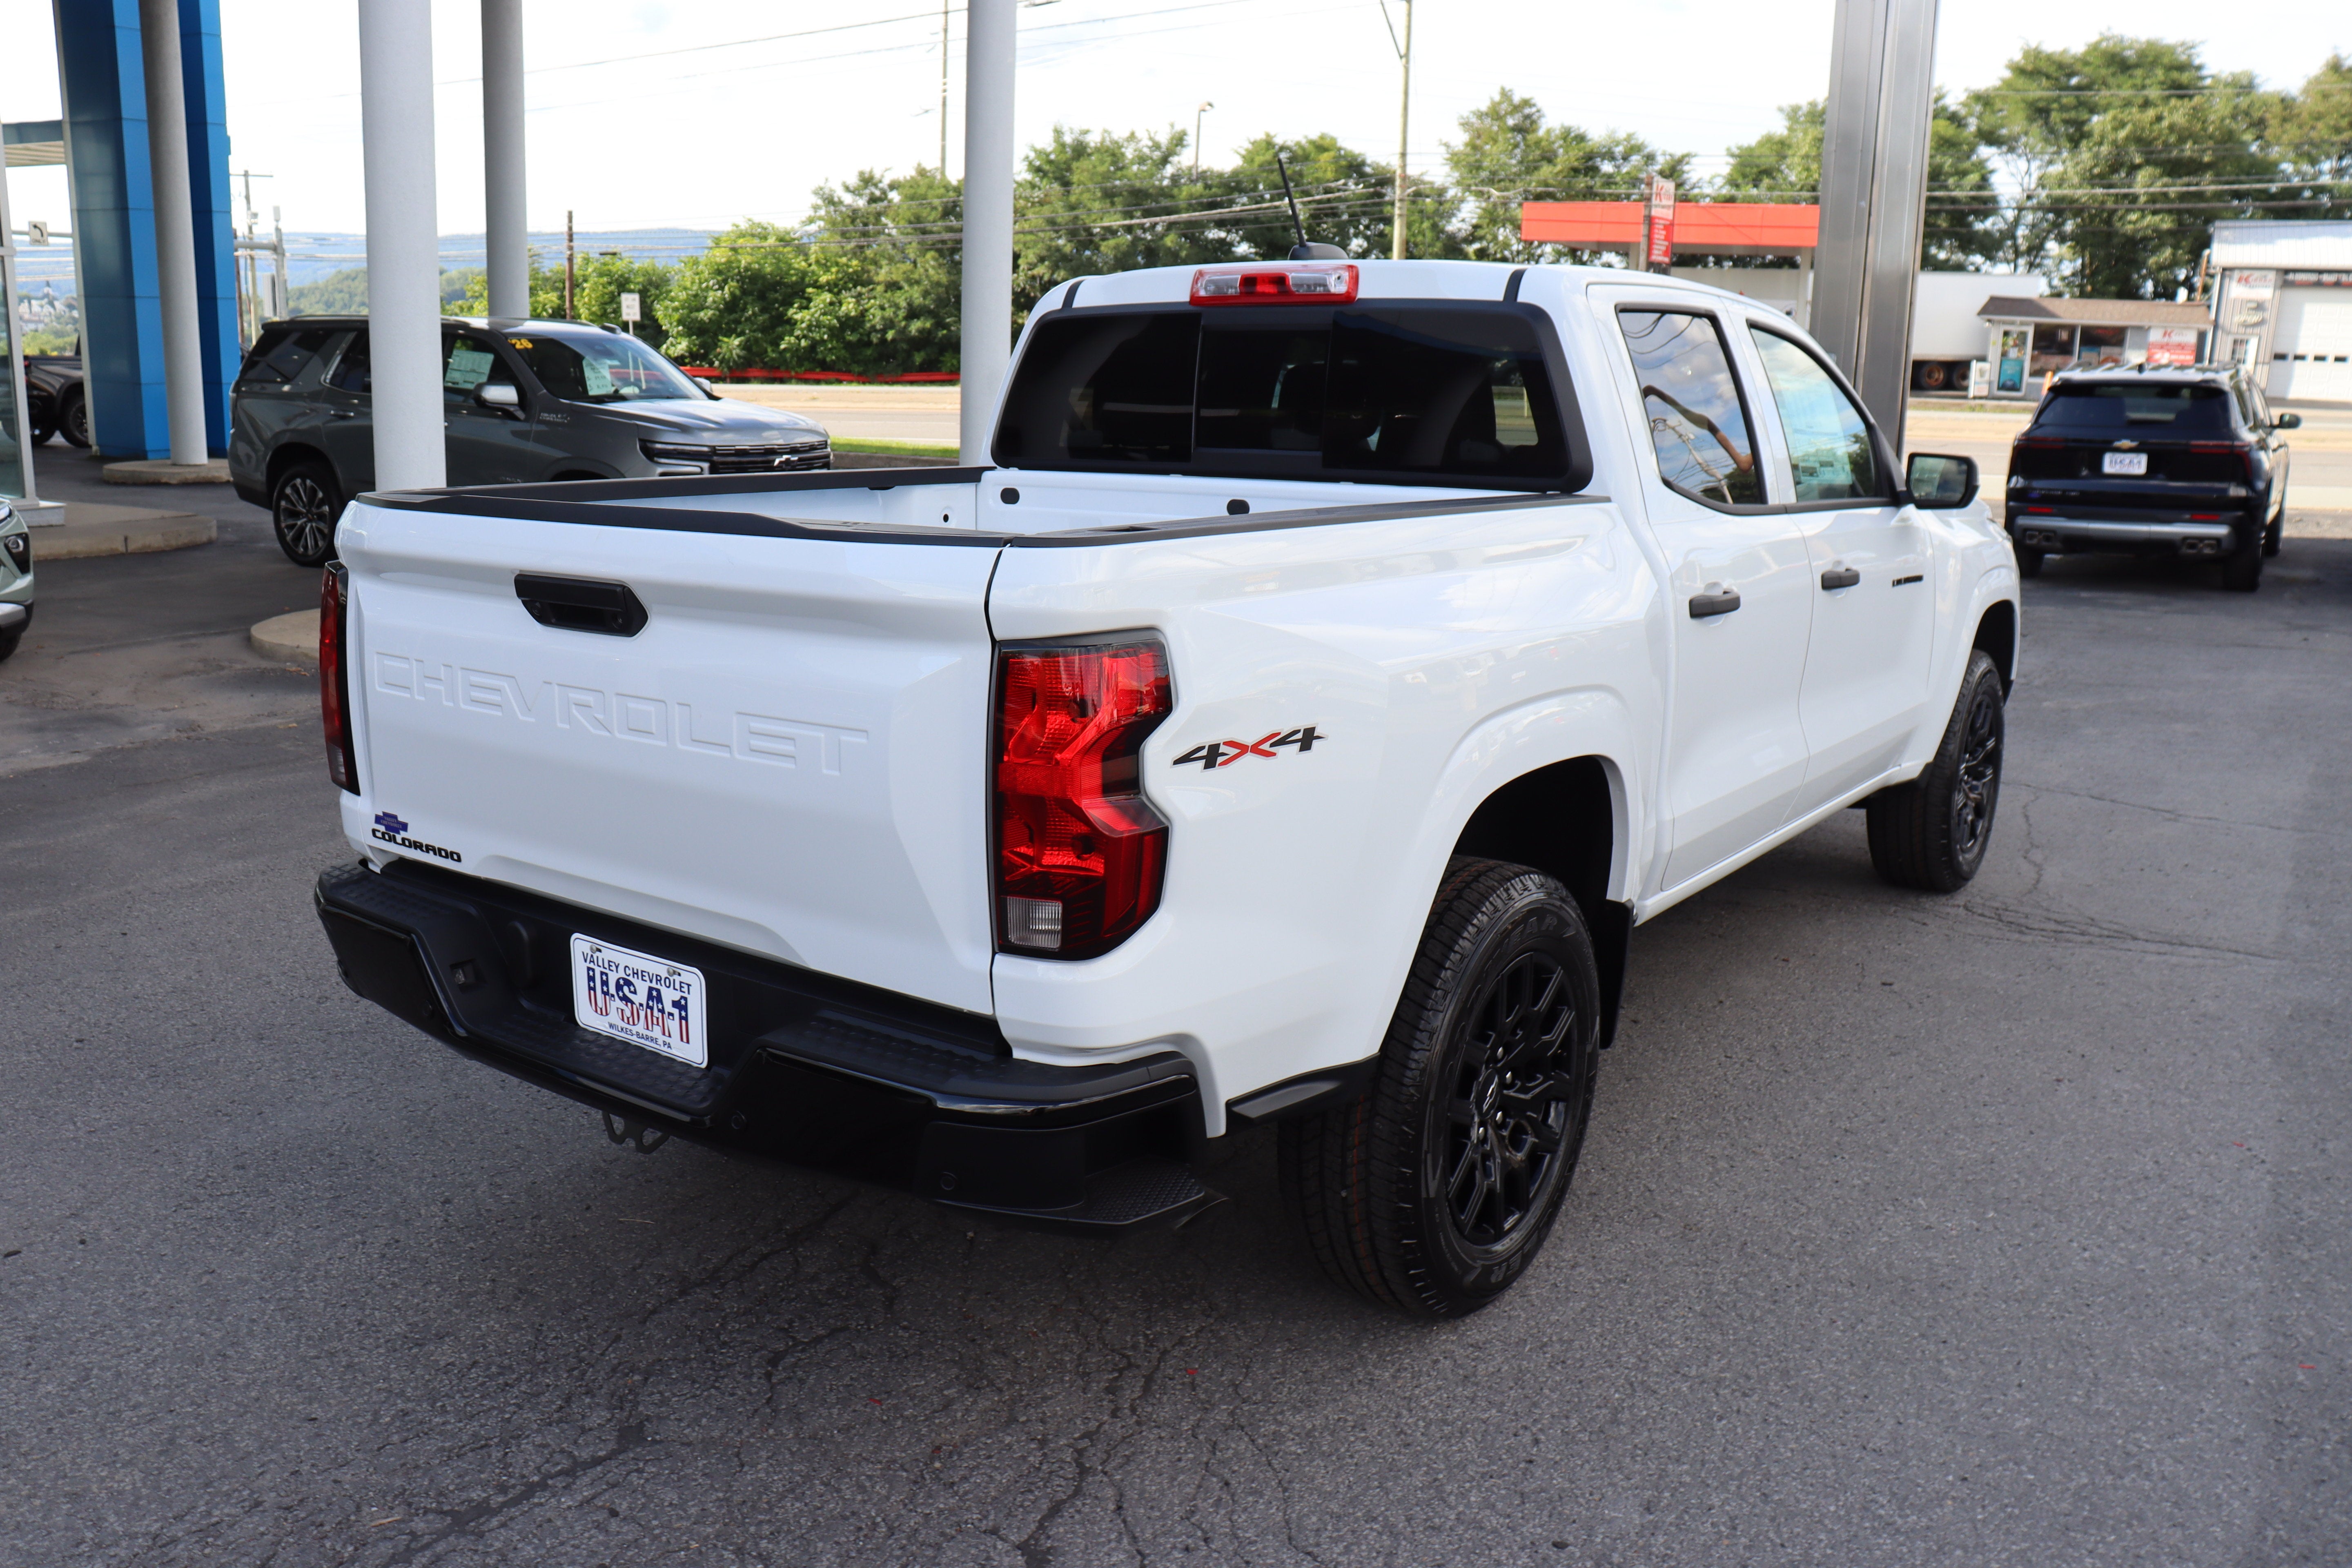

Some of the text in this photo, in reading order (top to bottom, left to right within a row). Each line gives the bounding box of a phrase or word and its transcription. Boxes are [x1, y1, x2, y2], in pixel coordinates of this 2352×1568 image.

[375, 652, 869, 776] CHEVROLET
[381, 819, 402, 829] CHEVROLET
[372, 828, 462, 862] COLORADO
[581, 951, 692, 995] VALLEY CHEVROLET
[608, 1021, 672, 1050] WILKES-BARRE, PA
